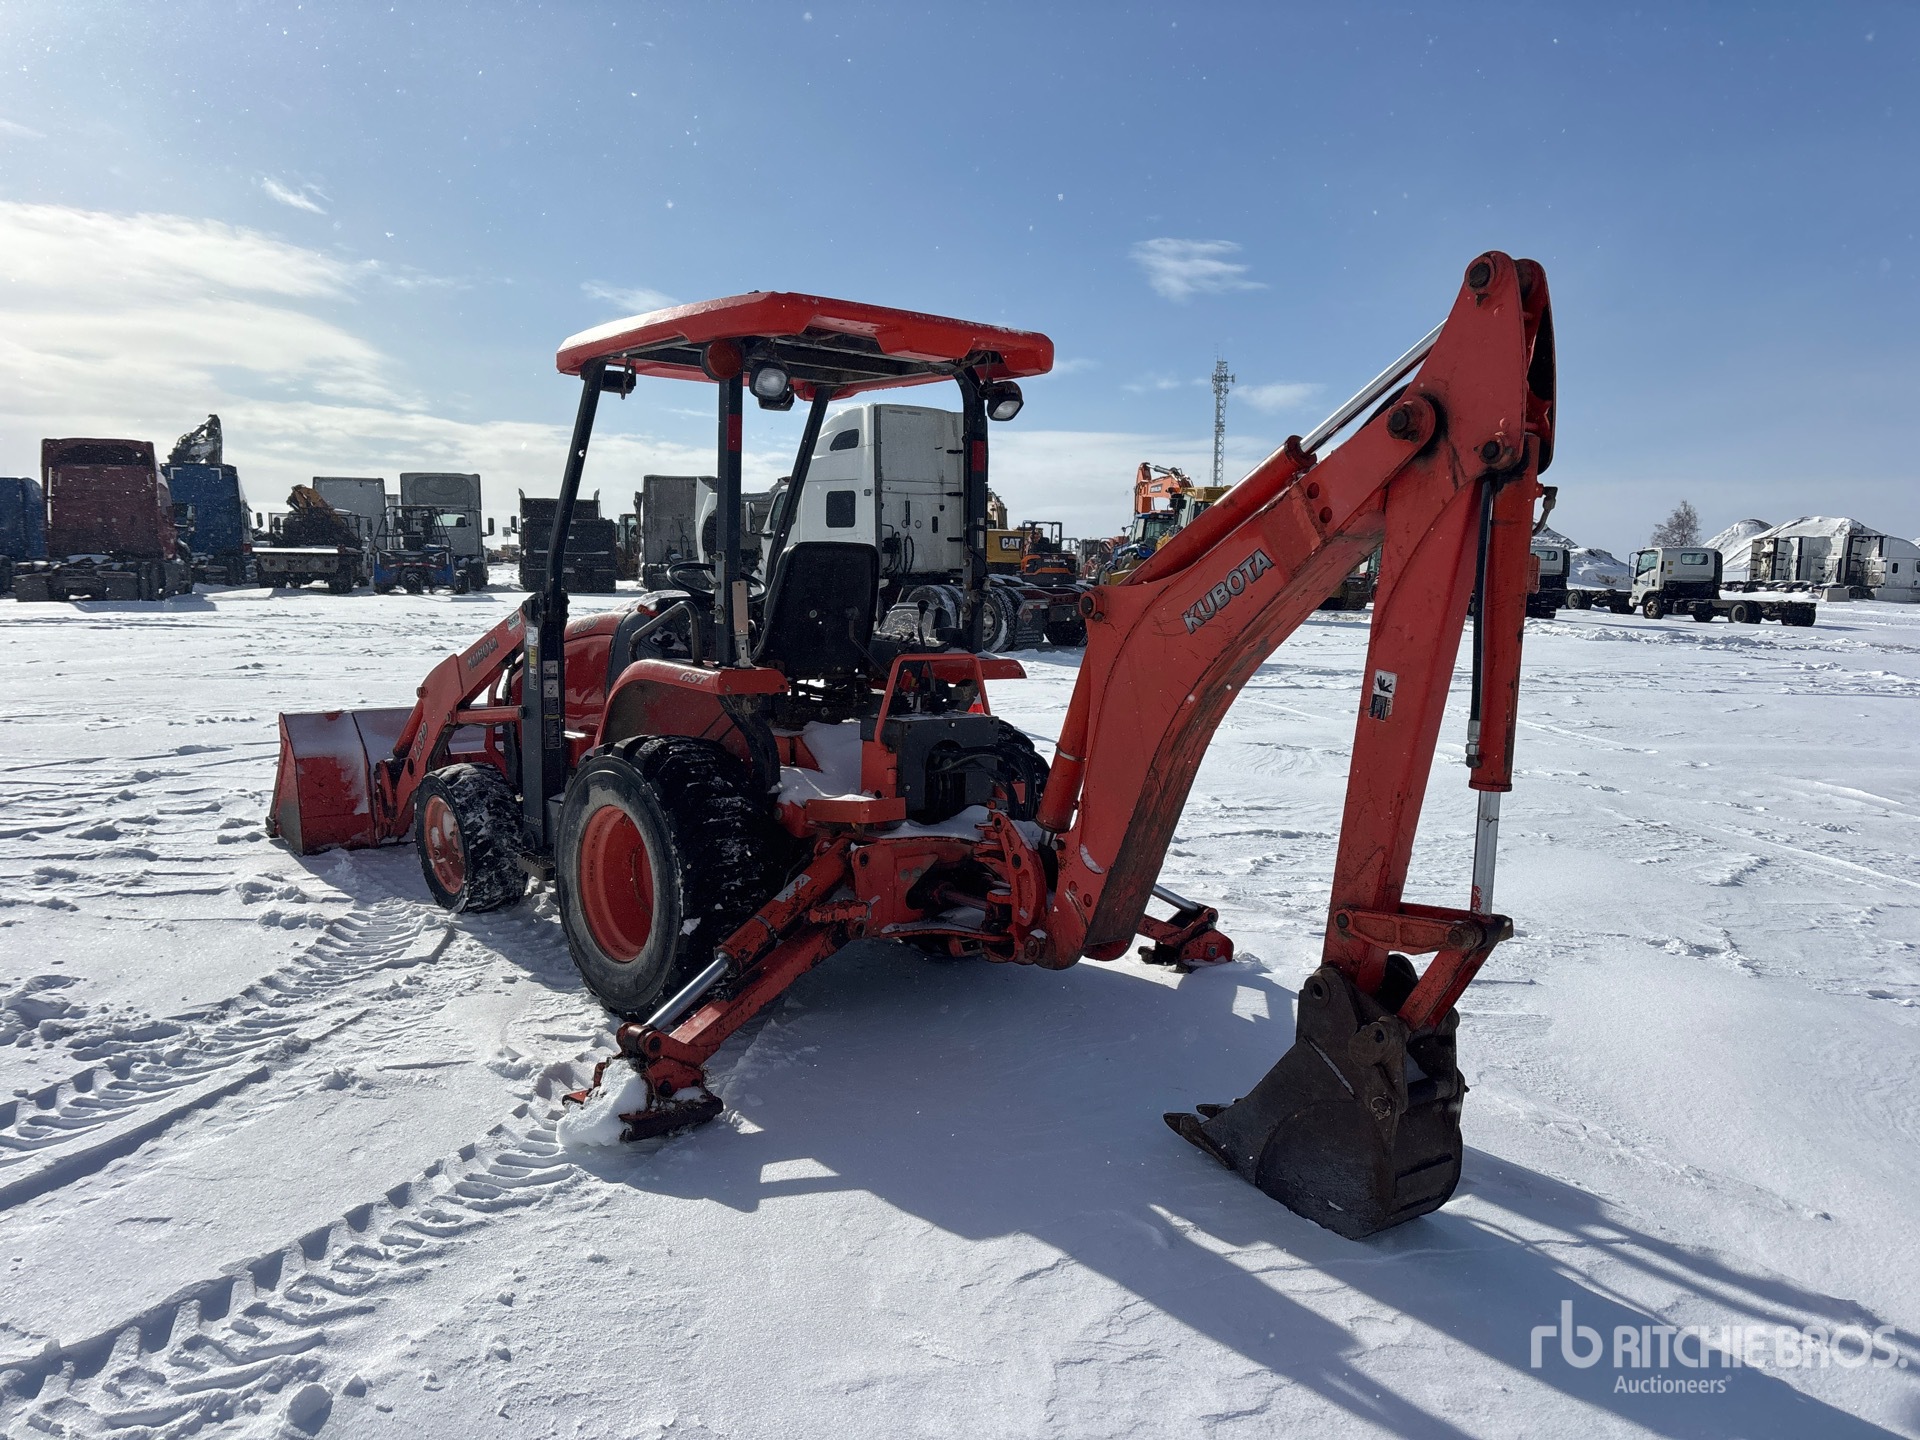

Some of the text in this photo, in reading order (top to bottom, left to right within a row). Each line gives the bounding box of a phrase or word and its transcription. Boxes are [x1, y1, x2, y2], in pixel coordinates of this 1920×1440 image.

[1002, 537, 1021, 549] CAT
[1182, 548, 1275, 635] KUBOTA
[467, 636, 499, 671] KUBOTA
[680, 671, 709, 685] GST
